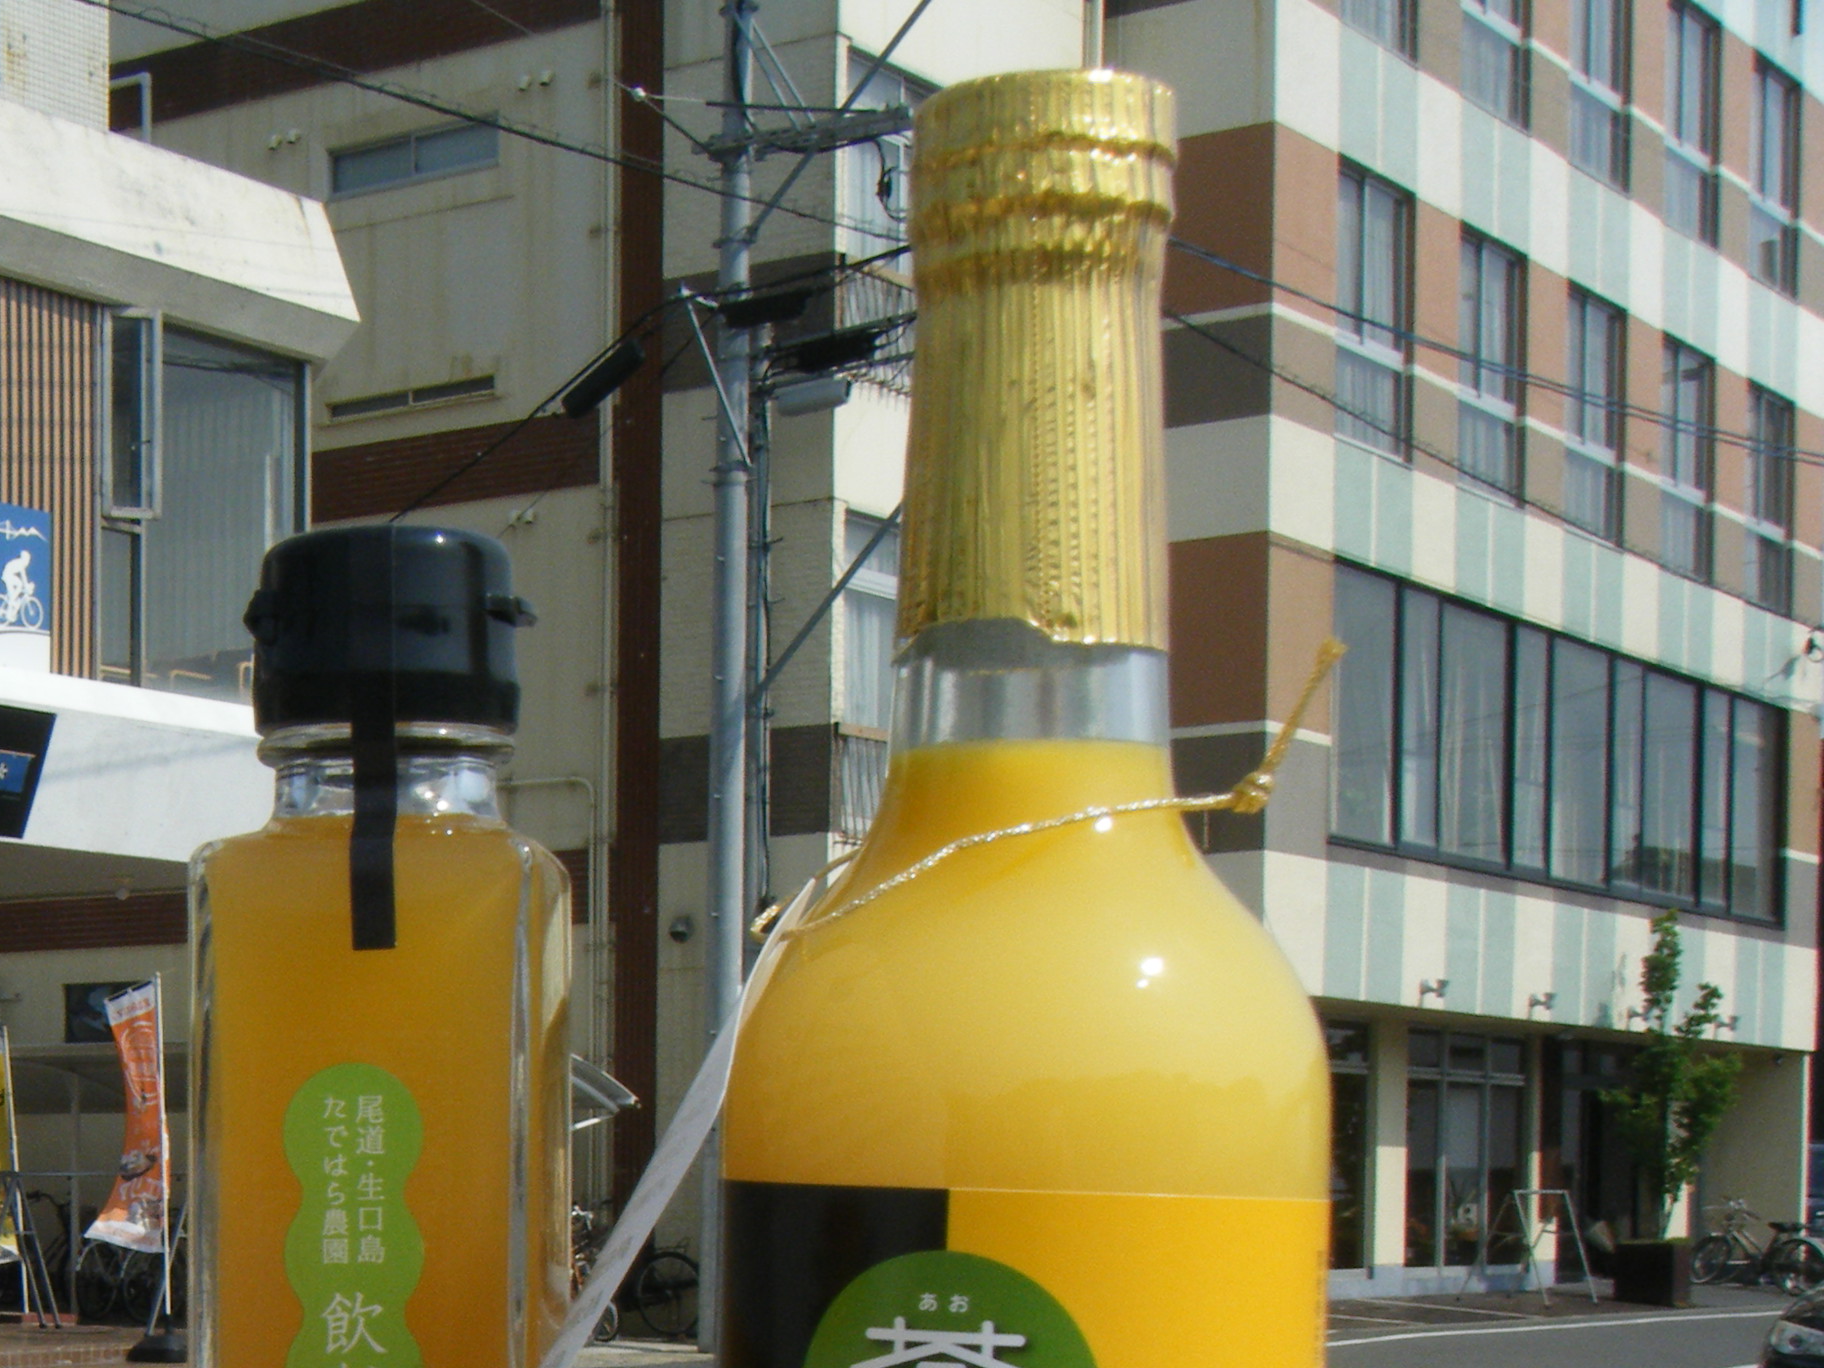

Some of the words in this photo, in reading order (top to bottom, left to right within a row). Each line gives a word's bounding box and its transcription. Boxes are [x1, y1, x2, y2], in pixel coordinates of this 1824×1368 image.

[322, 1096, 349, 1264] たではら農園
[355, 1094, 386, 1264] 尾道・生口島
[919, 1292, 970, 1313] あお
